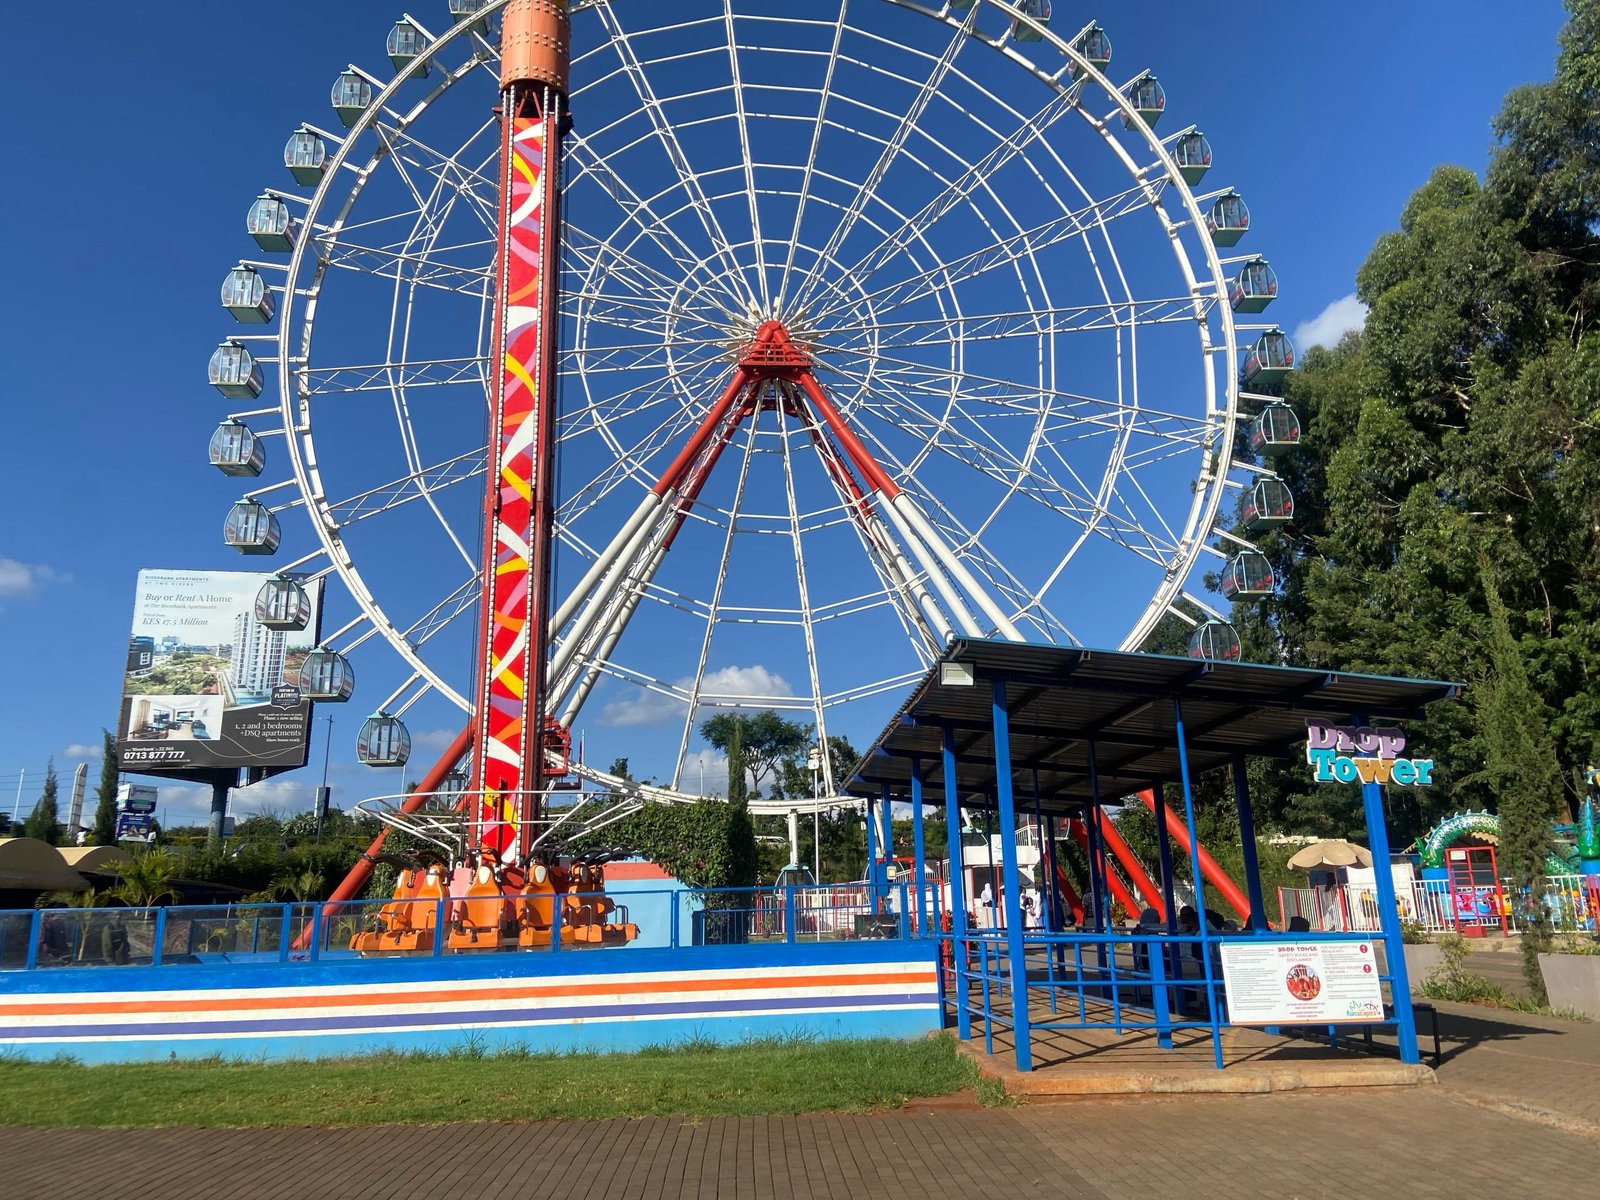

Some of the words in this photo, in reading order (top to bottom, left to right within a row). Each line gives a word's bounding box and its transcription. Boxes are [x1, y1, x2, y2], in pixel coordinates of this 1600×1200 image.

[145, 593, 162, 602] Buy
[175, 594, 196, 602] Rent
[1304, 718, 1406, 759] Drop
[124, 751, 147, 760] 0713
[148, 751, 166, 759] 877
[1306, 748, 1434, 786] Tower
